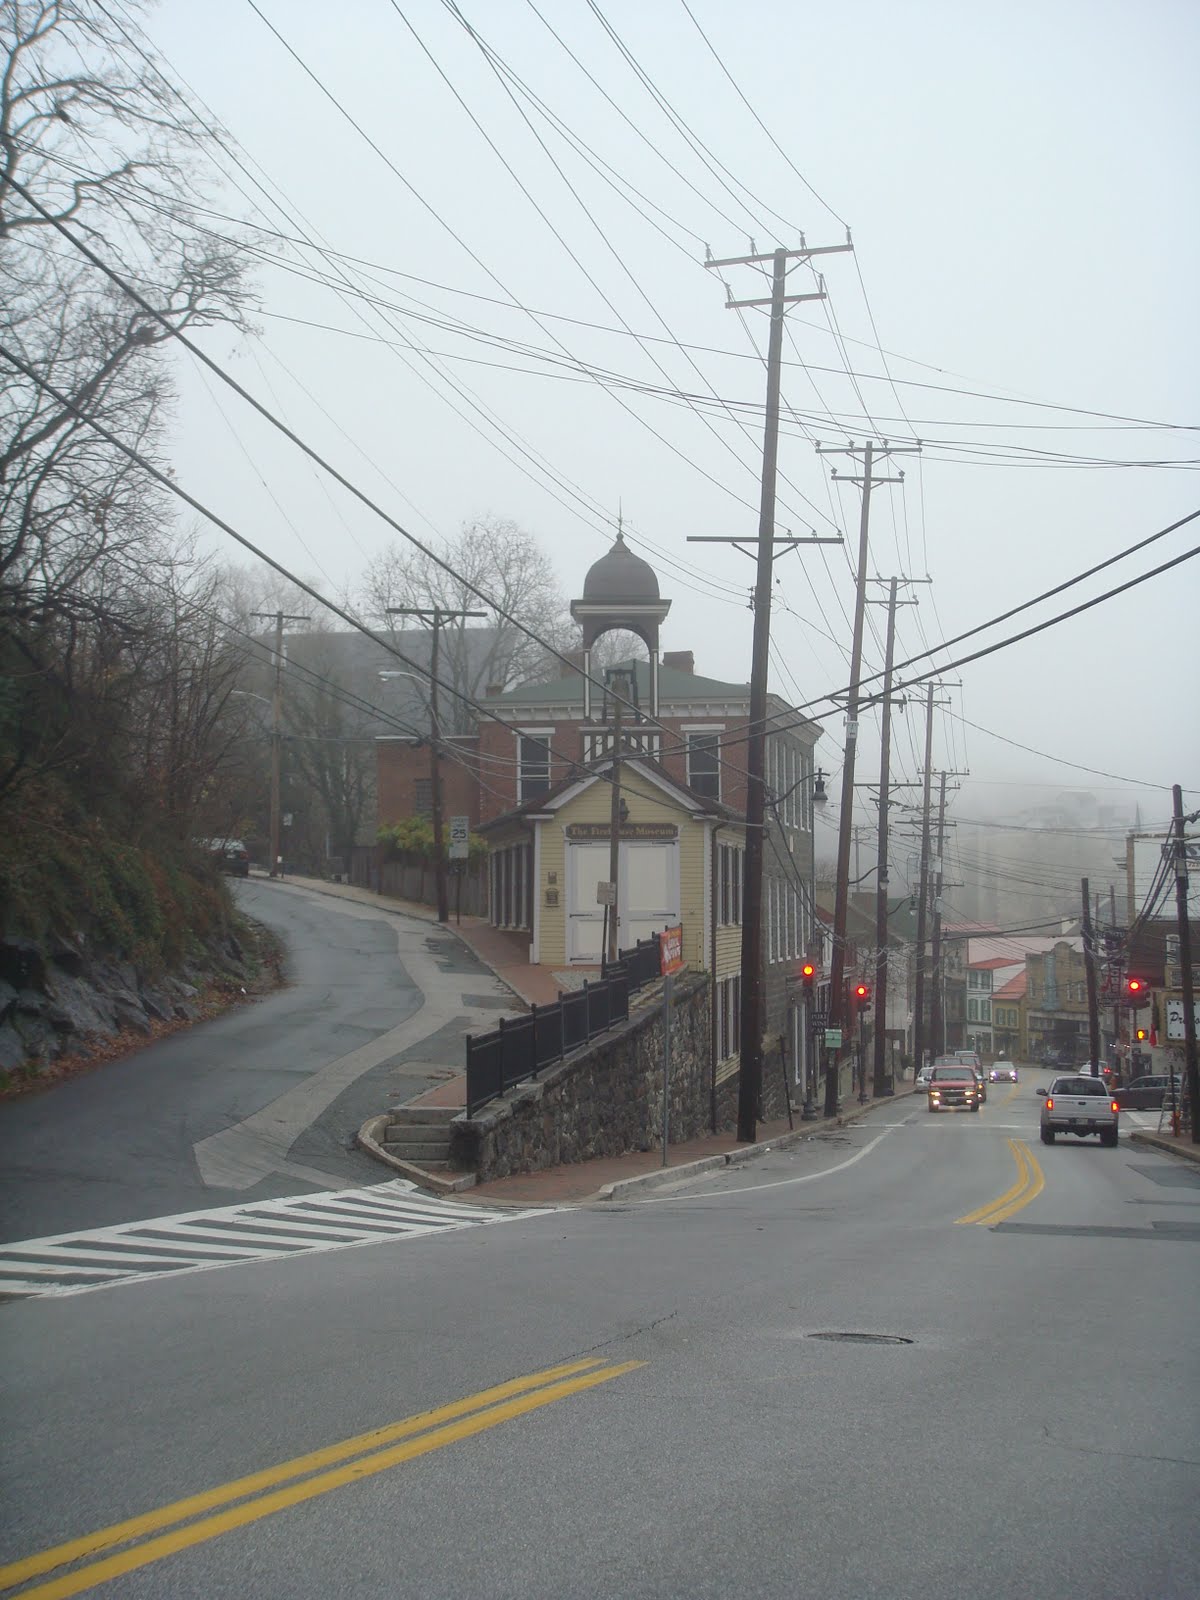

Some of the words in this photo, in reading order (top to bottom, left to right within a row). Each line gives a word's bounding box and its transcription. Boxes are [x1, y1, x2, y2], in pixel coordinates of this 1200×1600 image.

[452, 828, 467, 839] 25
[571, 826, 587, 835] The
[636, 826, 674, 835] Museum
